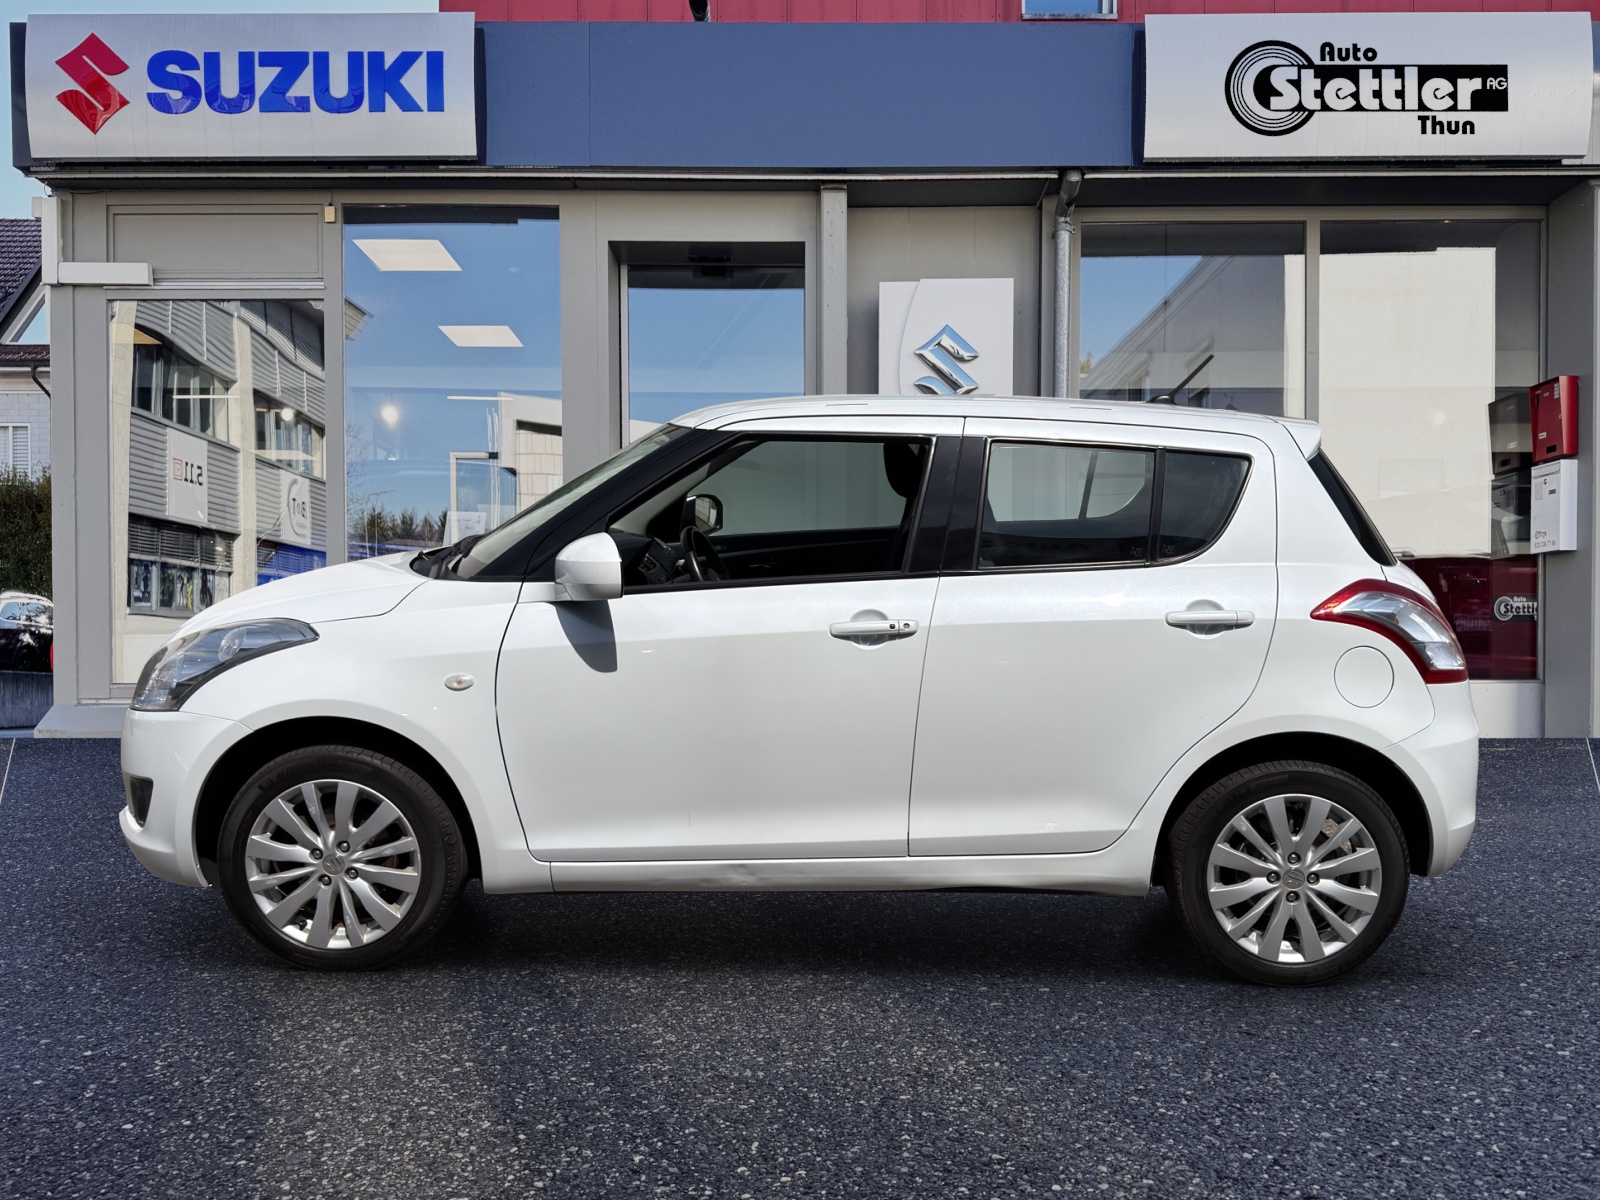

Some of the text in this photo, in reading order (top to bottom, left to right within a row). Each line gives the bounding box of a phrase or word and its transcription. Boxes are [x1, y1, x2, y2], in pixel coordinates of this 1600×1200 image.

[1319, 42, 1377, 62] Auto
[146, 50, 445, 114] SUZUKI
[1269, 65, 1507, 111] Stettler AG
[1417, 115, 1475, 135] Thun
